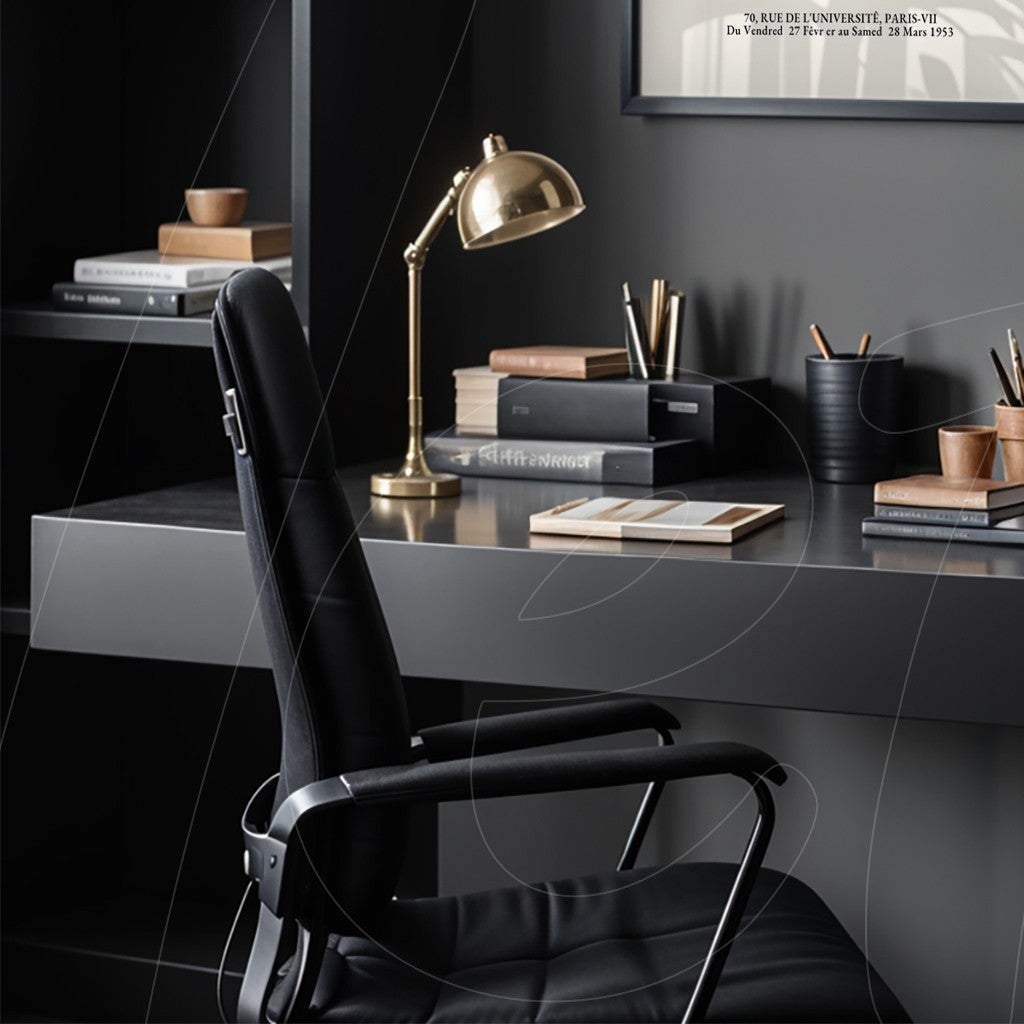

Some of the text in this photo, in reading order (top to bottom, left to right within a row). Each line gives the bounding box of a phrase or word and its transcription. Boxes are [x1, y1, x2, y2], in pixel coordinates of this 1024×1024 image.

[743, 12, 759, 25] 70,
[760, 12, 784, 24] RUE
[785, 12, 801, 24] DE
[884, 13, 937, 24] PARIS-VII
[726, 25, 741, 36] Du
[743, 24, 783, 36] Vendred
[788, 25, 801, 36] 27
[837, 29, 850, 37] au
[851, 25, 883, 37] Samed
[888, 26, 901, 37] 28
[902, 26, 927, 37] Mars
[930, 26, 954, 38] 1953
